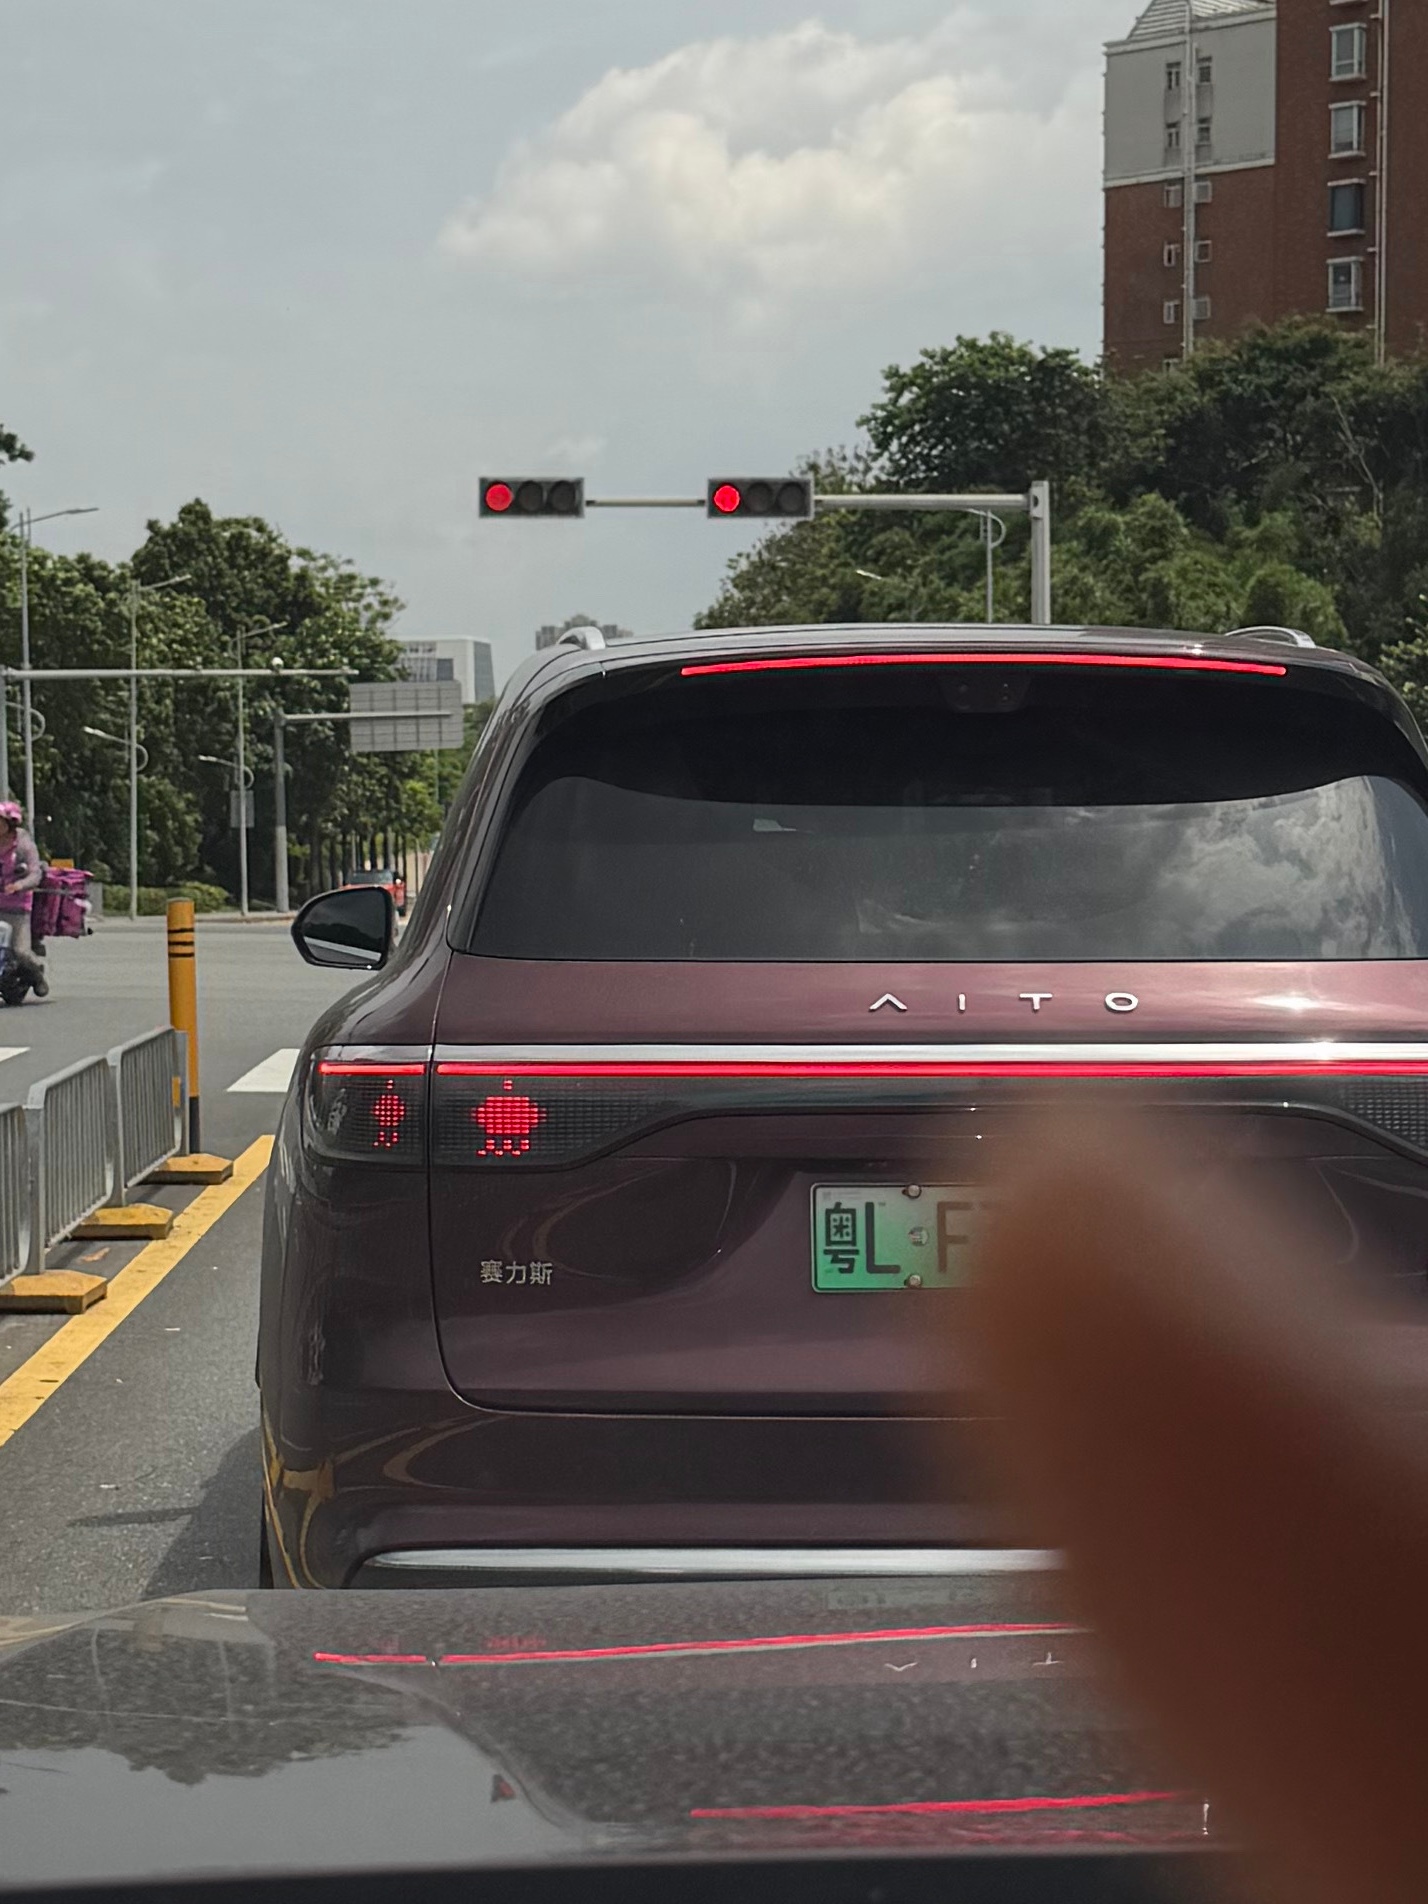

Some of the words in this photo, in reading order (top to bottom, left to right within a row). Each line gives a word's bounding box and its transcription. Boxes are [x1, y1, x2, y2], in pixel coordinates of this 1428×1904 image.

[869, 993, 1138, 1012] AITO
[480, 1259, 553, 1285] 赛力斯
